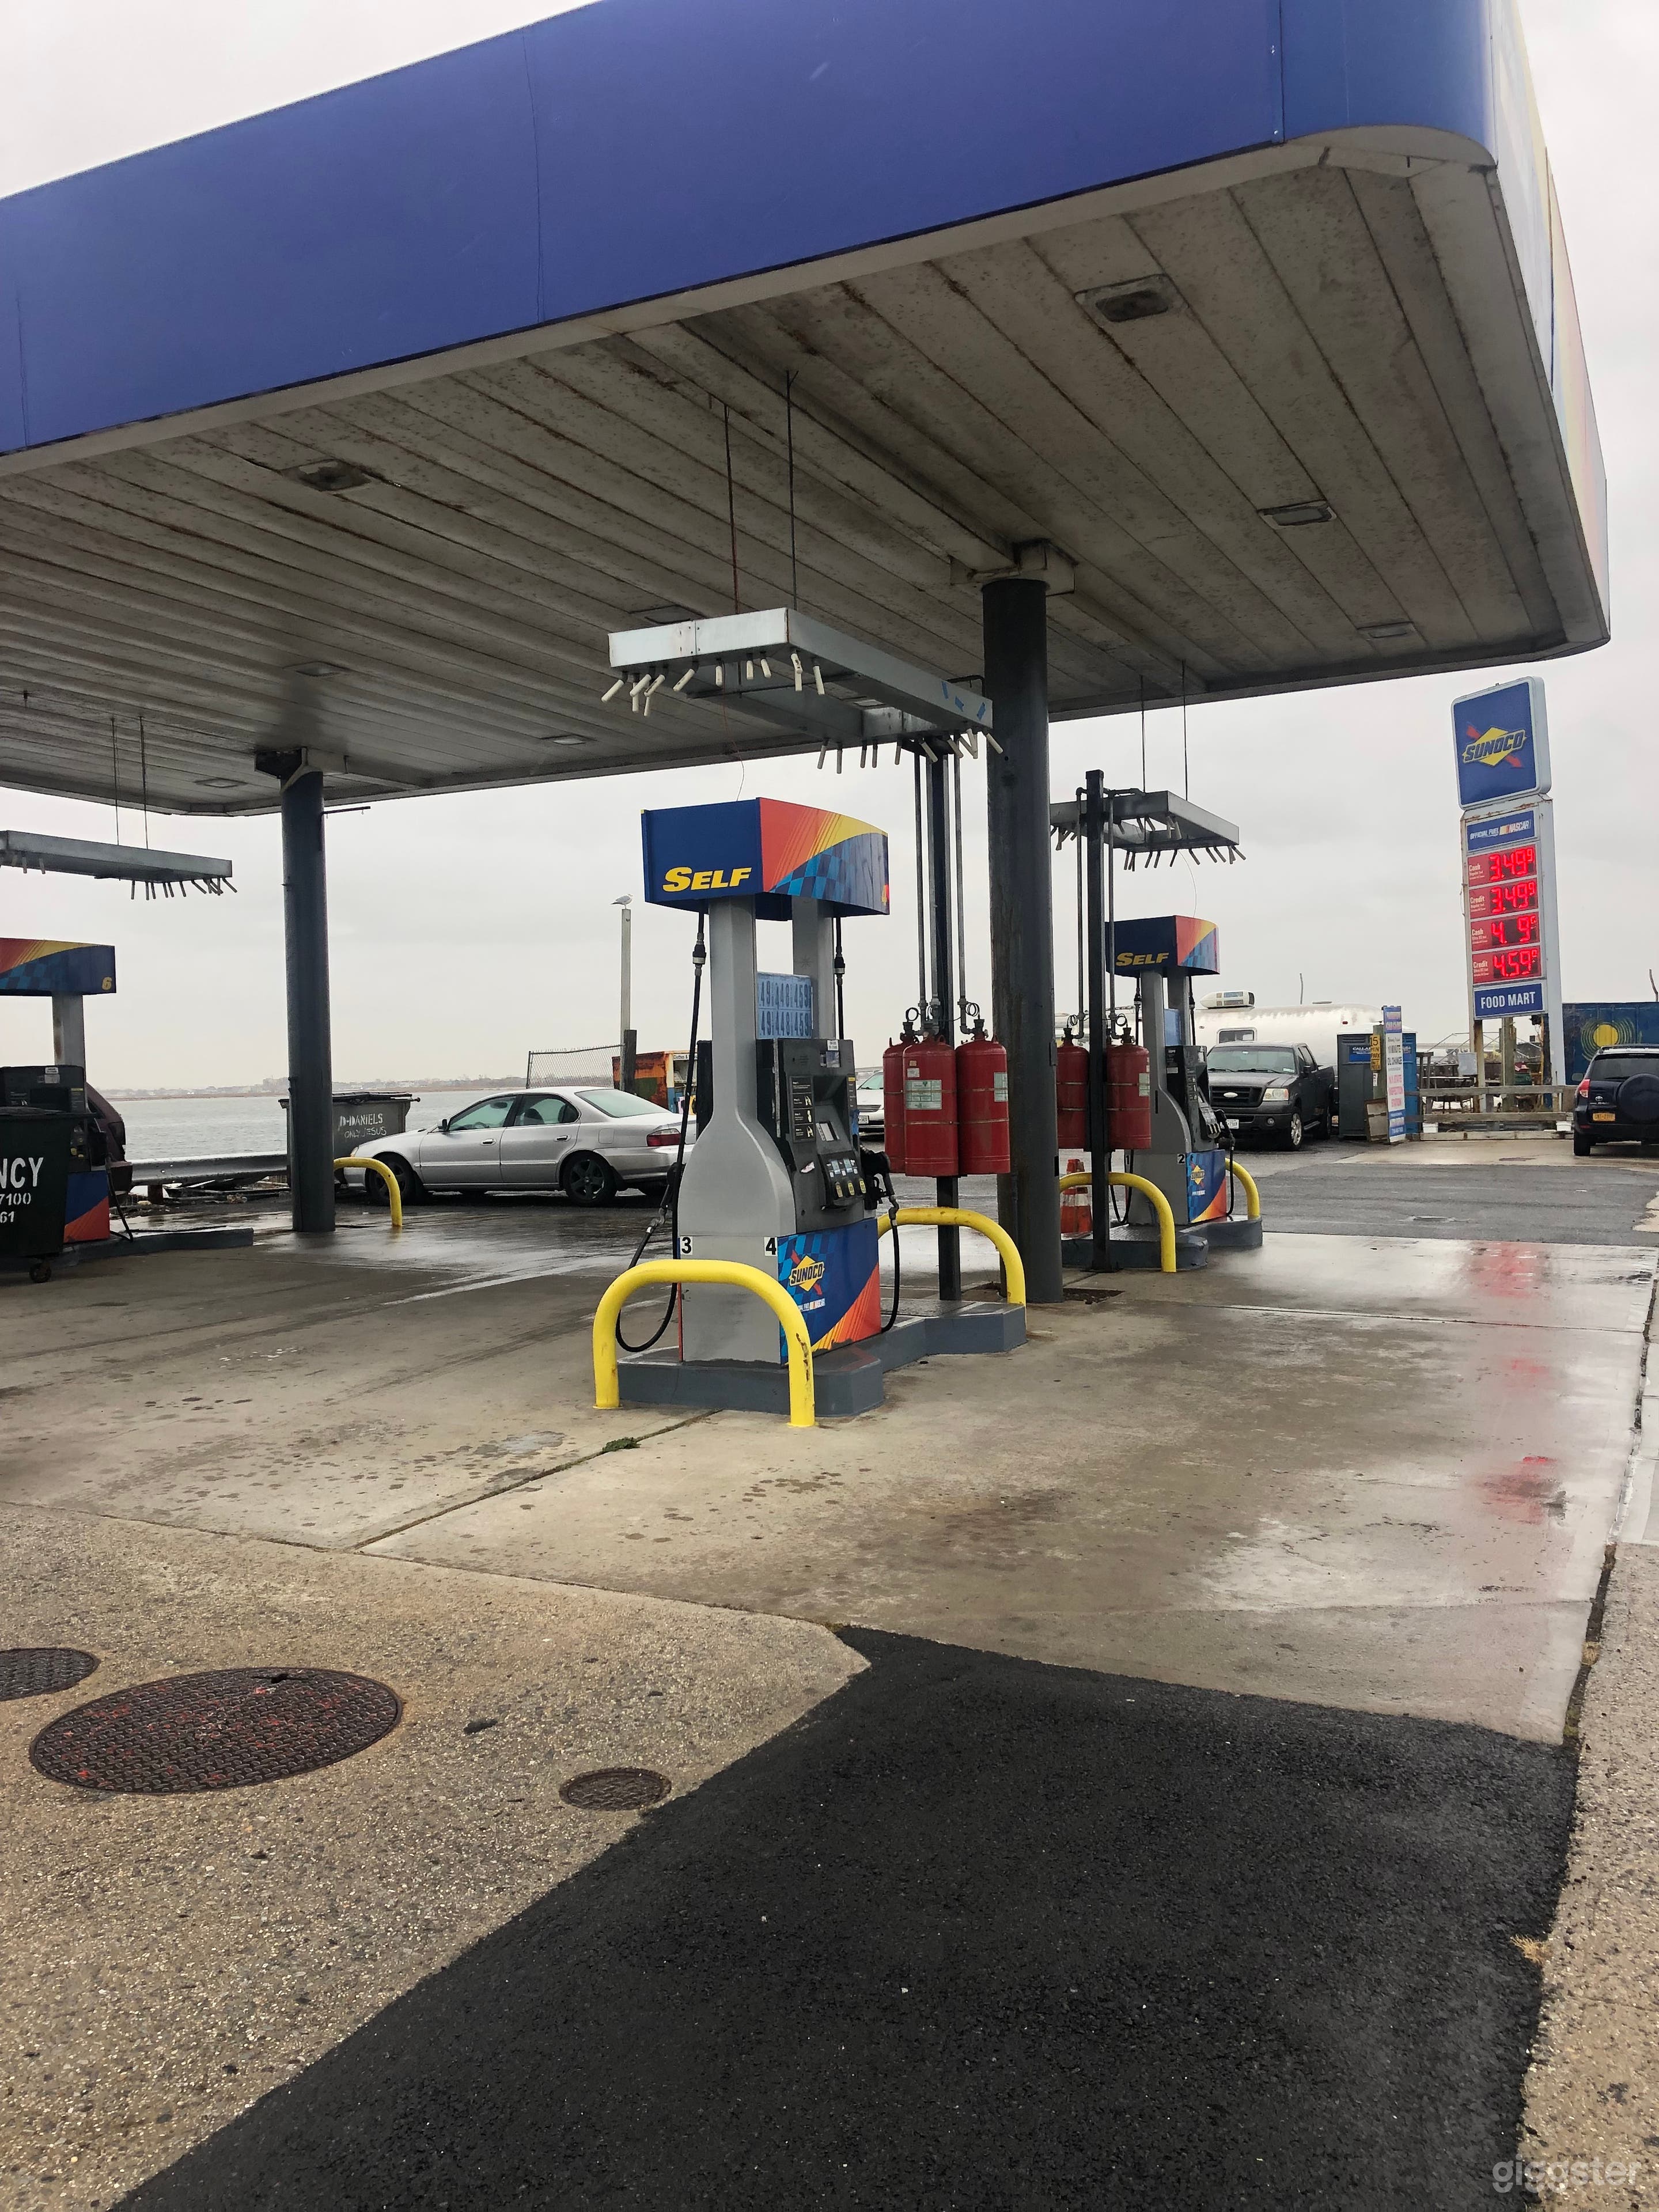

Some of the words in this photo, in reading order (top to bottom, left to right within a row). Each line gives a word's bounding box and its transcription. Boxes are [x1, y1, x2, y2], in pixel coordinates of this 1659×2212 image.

[1464, 732, 1525, 761] SUNOCO
[1509, 820, 1531, 833] NASCAR
[1469, 863, 1480, 872] Cash
[662, 866, 752, 892] SELF
[1470, 895, 1485, 904] Credit
[1472, 928, 1484, 936] Cash
[1116, 952, 1169, 967] SELF
[1474, 960, 1488, 968] Credit
[101, 976, 112, 990] 6
[1481, 995, 1505, 1009] FOOD
[1508, 991, 1536, 1006] MART
[1370, 1036, 1378, 1046] 15
[344, 1129, 361, 1138] ONLY
[361, 1126, 387, 1137] JESUS
[1126, 1155, 1130, 1165] 1
[1178, 1154, 1185, 1164] 2
[0, 1193, 31, 1206] 7100
[0, 1211, 14, 1223] 61
[681, 1237, 691, 1253] 3
[766, 1237, 777, 1255] 4
[791, 1263, 823, 1284] SUNOCO
